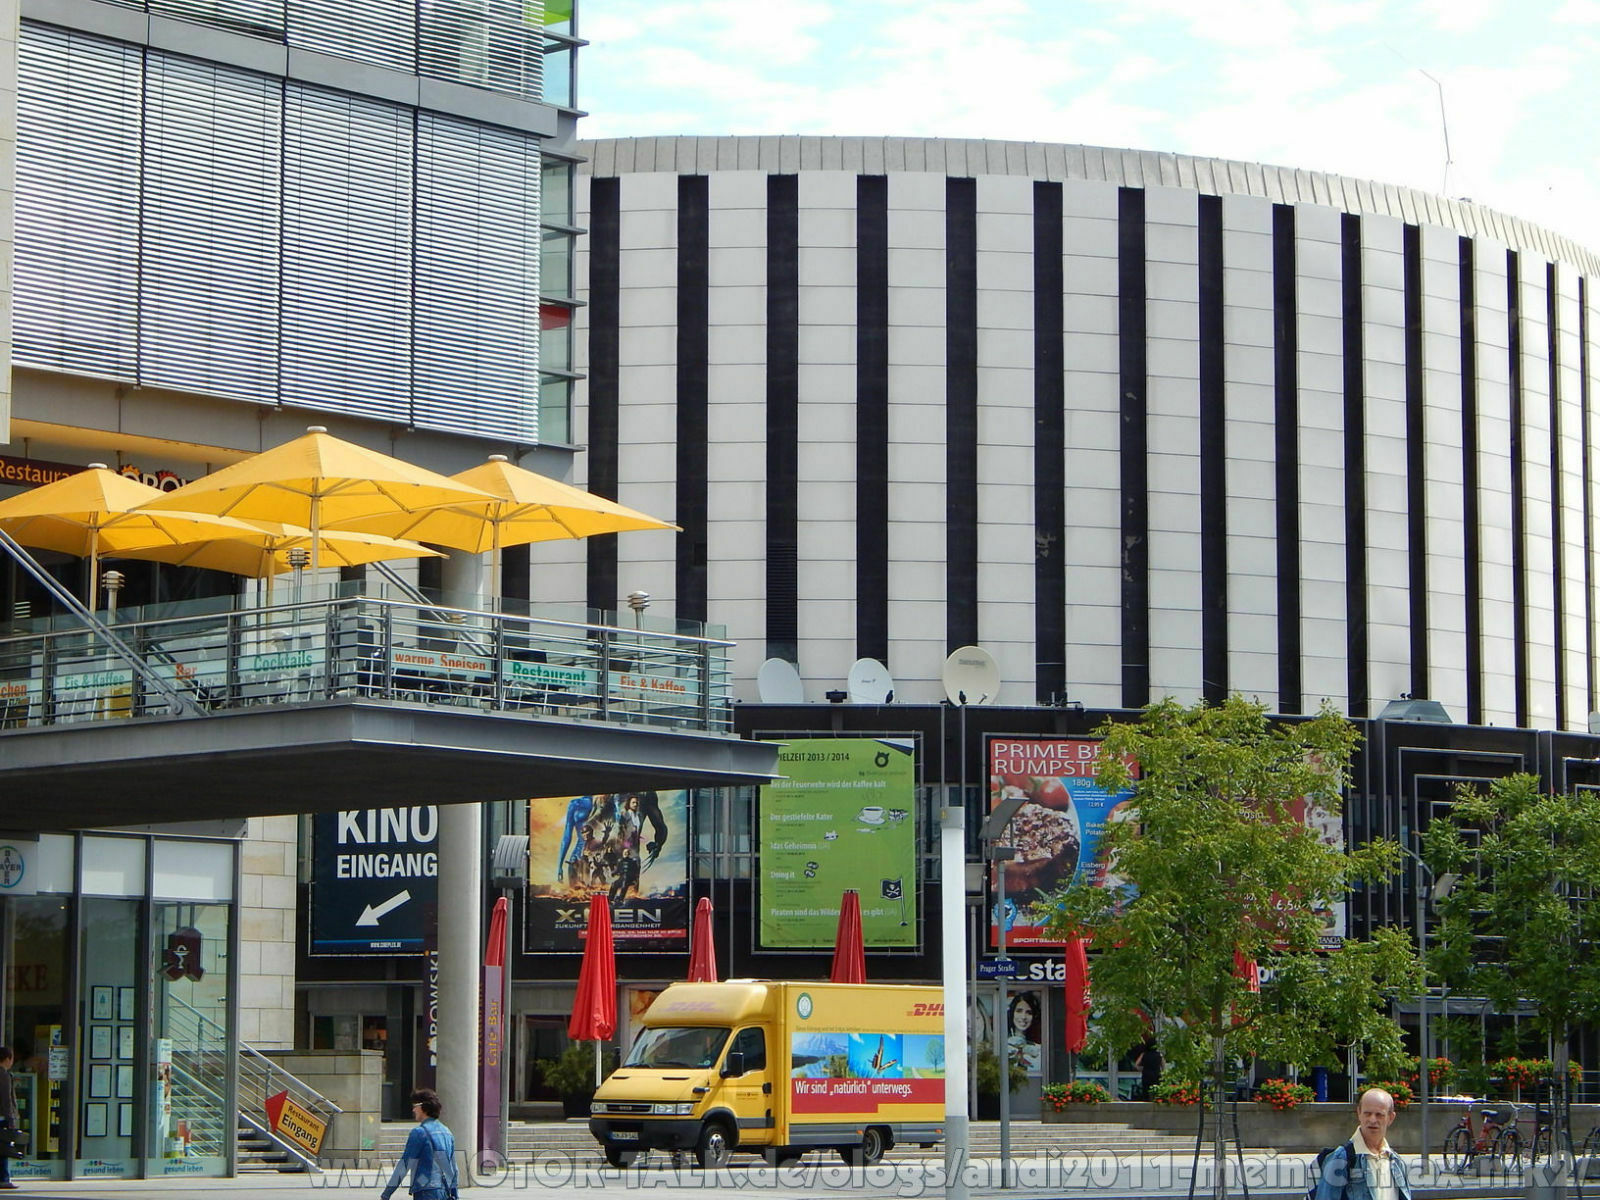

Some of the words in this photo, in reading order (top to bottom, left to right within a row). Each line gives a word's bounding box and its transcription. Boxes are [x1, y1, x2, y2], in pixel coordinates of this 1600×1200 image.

[253, 650, 313, 672] Cocktails
[512, 662, 588, 686] Restaurant
[0, 680, 27, 698] chen
[779, 752, 806, 762] IELZEIT
[807, 752, 826, 762] 2013
[831, 752, 850, 762] 2014
[994, 743, 1069, 759] PRIME
[994, 759, 1135, 776] RUMPSTEK
[853, 780, 872, 788] Kaffee
[338, 805, 438, 844] KINO
[337, 852, 438, 879] EINGANG
[555, 908, 662, 923] X-EN
[980, 964, 997, 973] Prager
[998, 964, 1016, 973] Straße
[795, 1081, 808, 1094] Wir
[811, 1080, 827, 1094] sind
[872, 1082, 912, 1097] unterwegs.
[287, 1105, 320, 1132] Restaurant
[281, 1113, 318, 1149] Eingang
[10, 1167, 32, 1177] gesund
[33, 1167, 52, 1175] leben
[83, 1167, 105, 1176] gesund
[106, 1166, 124, 1174] leben
[164, 1165, 184, 1175] gesund
[185, 1164, 204, 1173] leben
